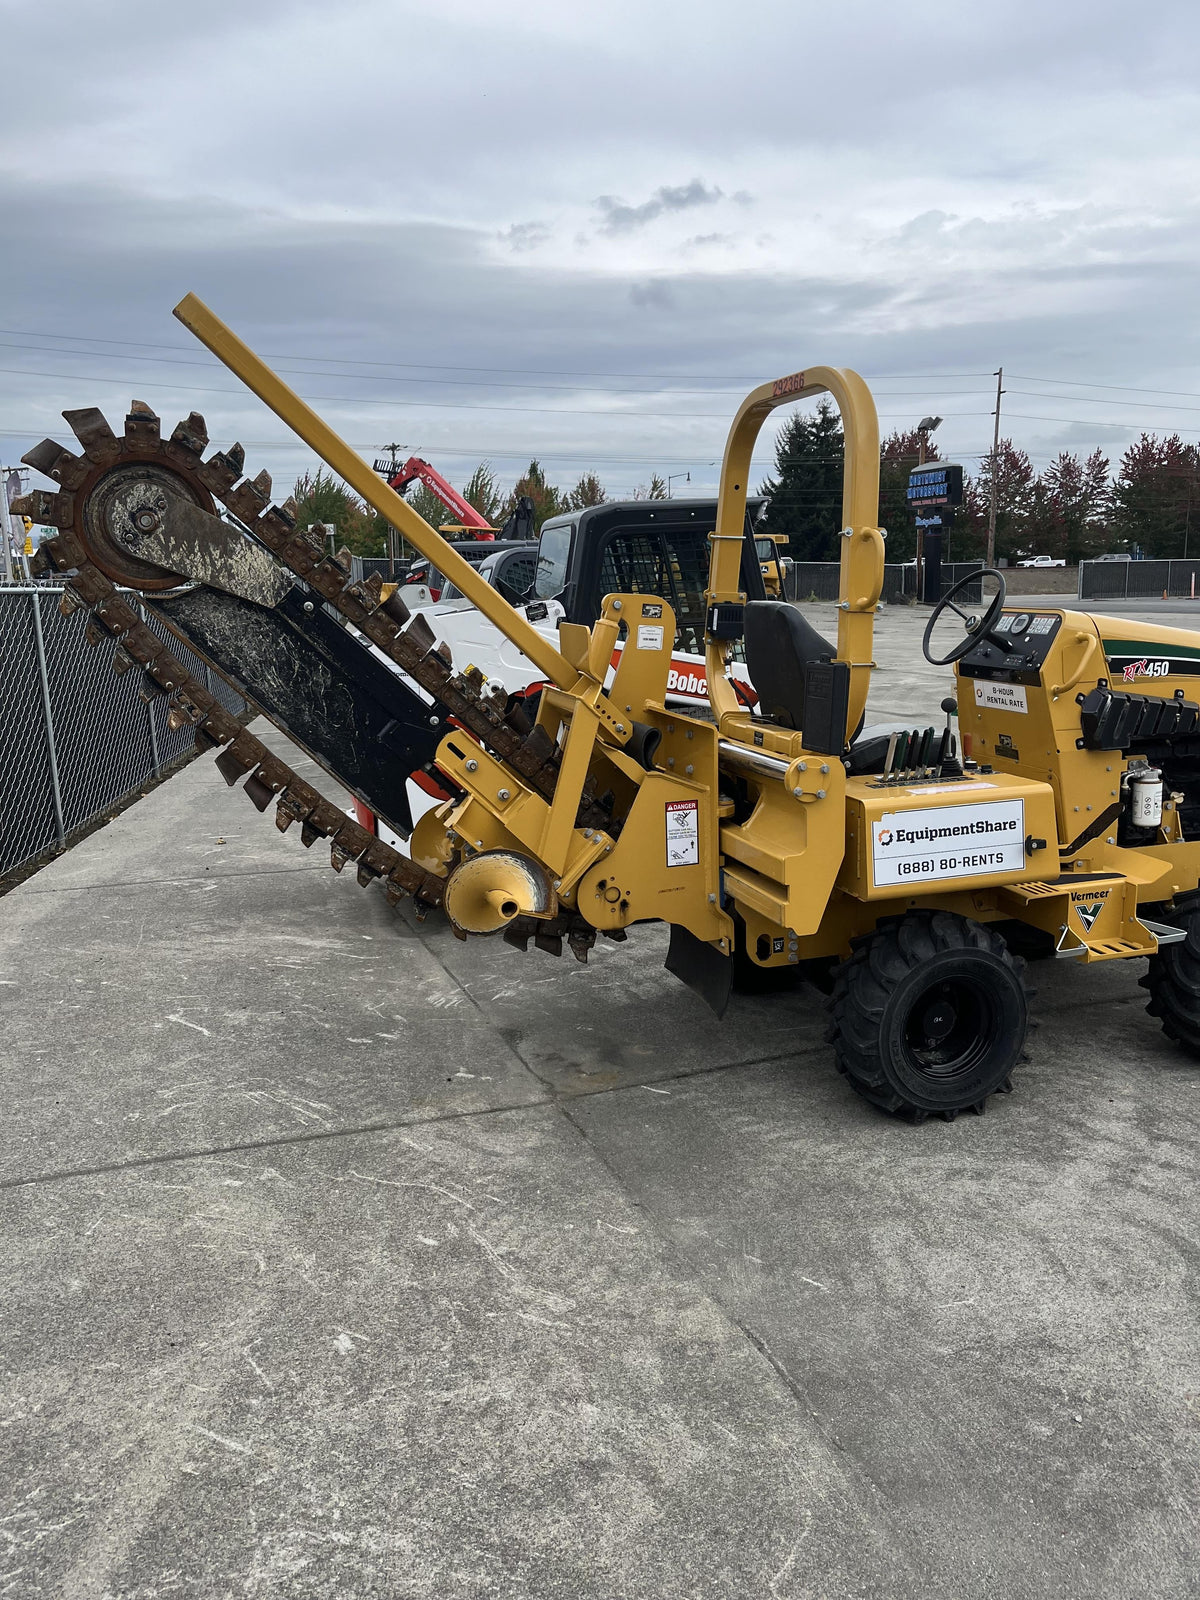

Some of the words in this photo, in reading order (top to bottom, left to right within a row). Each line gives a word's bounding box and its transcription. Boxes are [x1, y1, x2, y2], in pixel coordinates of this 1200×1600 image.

[772, 372, 805, 397] 292366
[667, 669, 709, 695] Bobc
[986, 695, 1008, 706] RENTAL
[1009, 699, 1024, 708] RATE
[896, 820, 1017, 844] EquipmentShare
[897, 859, 935, 876] (888)
[940, 852, 1004, 870] 80-RENTS
[1070, 890, 1110, 902] Vermeer
